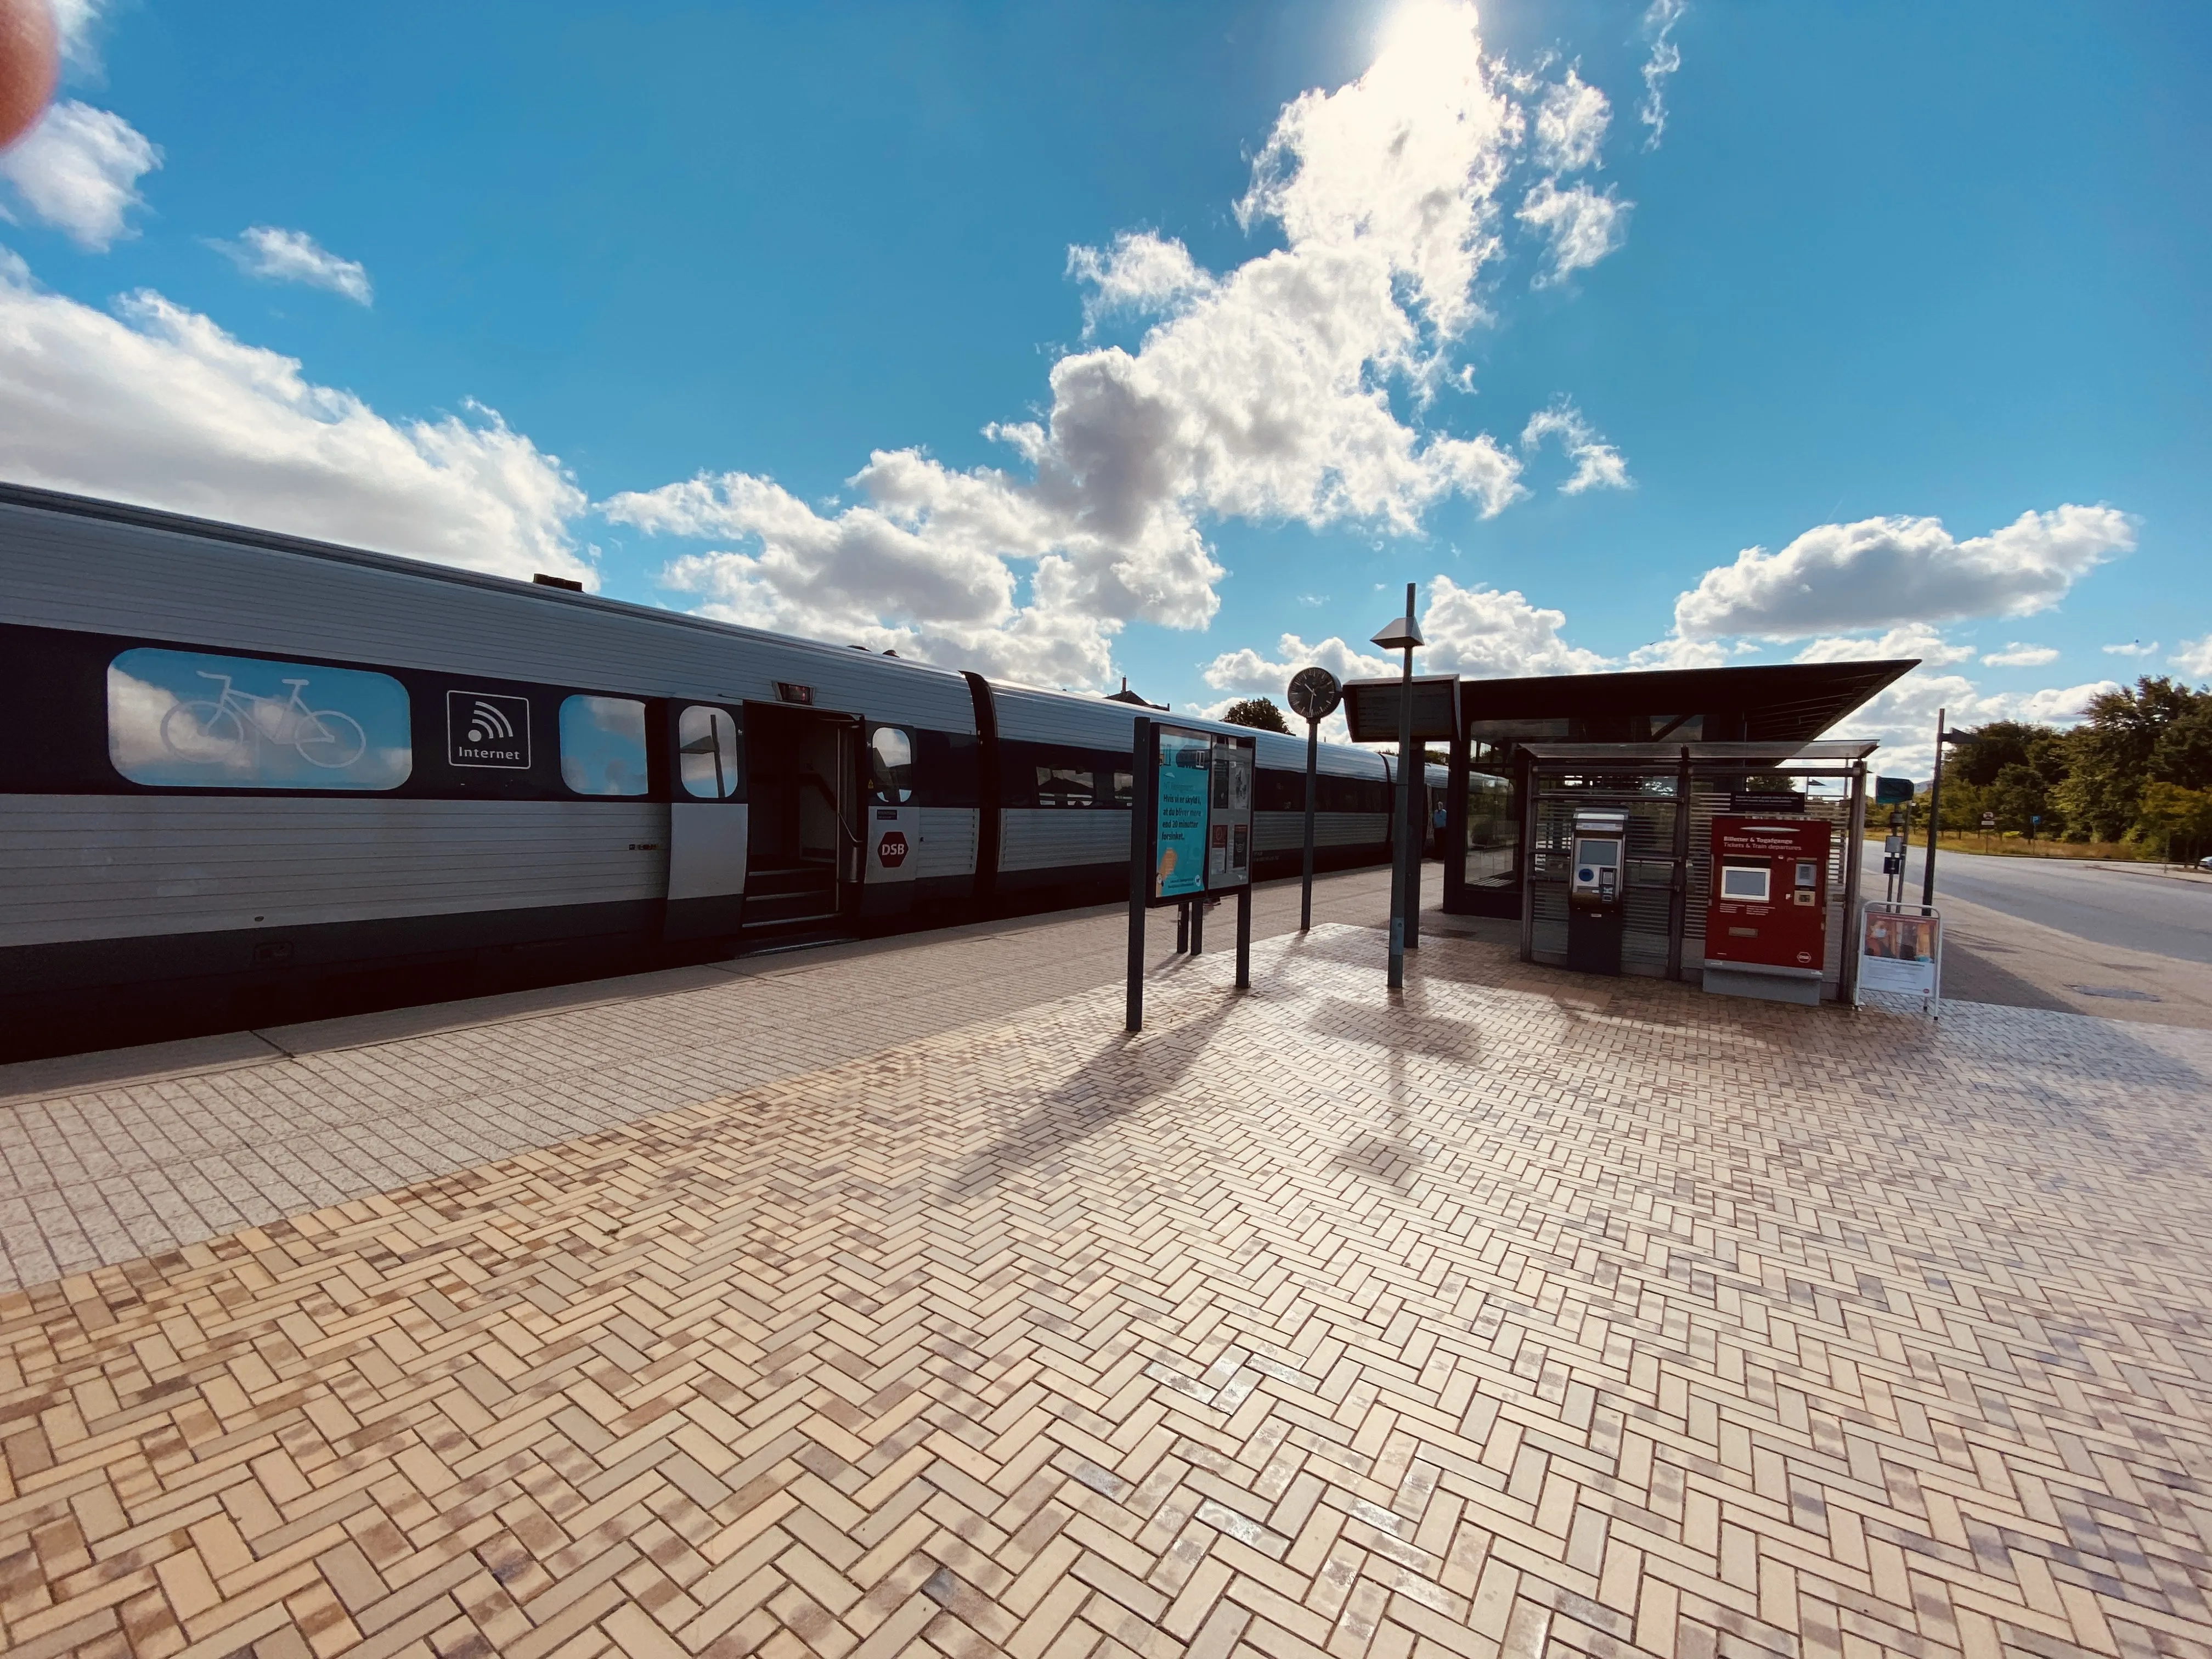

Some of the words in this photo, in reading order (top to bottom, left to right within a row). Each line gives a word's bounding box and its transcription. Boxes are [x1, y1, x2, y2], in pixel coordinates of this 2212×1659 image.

[459, 746, 521, 760] Internet
[1163, 794, 1174, 803] Hvis
[1174, 794, 1179, 803] vi
[1163, 808, 1168, 816] at
[1169, 808, 1175, 816] du
[1175, 808, 1189, 816] bliver
[1162, 820, 1171, 828] end
[1161, 832, 1185, 841] forsinket.
[882, 843, 905, 855] DSB
